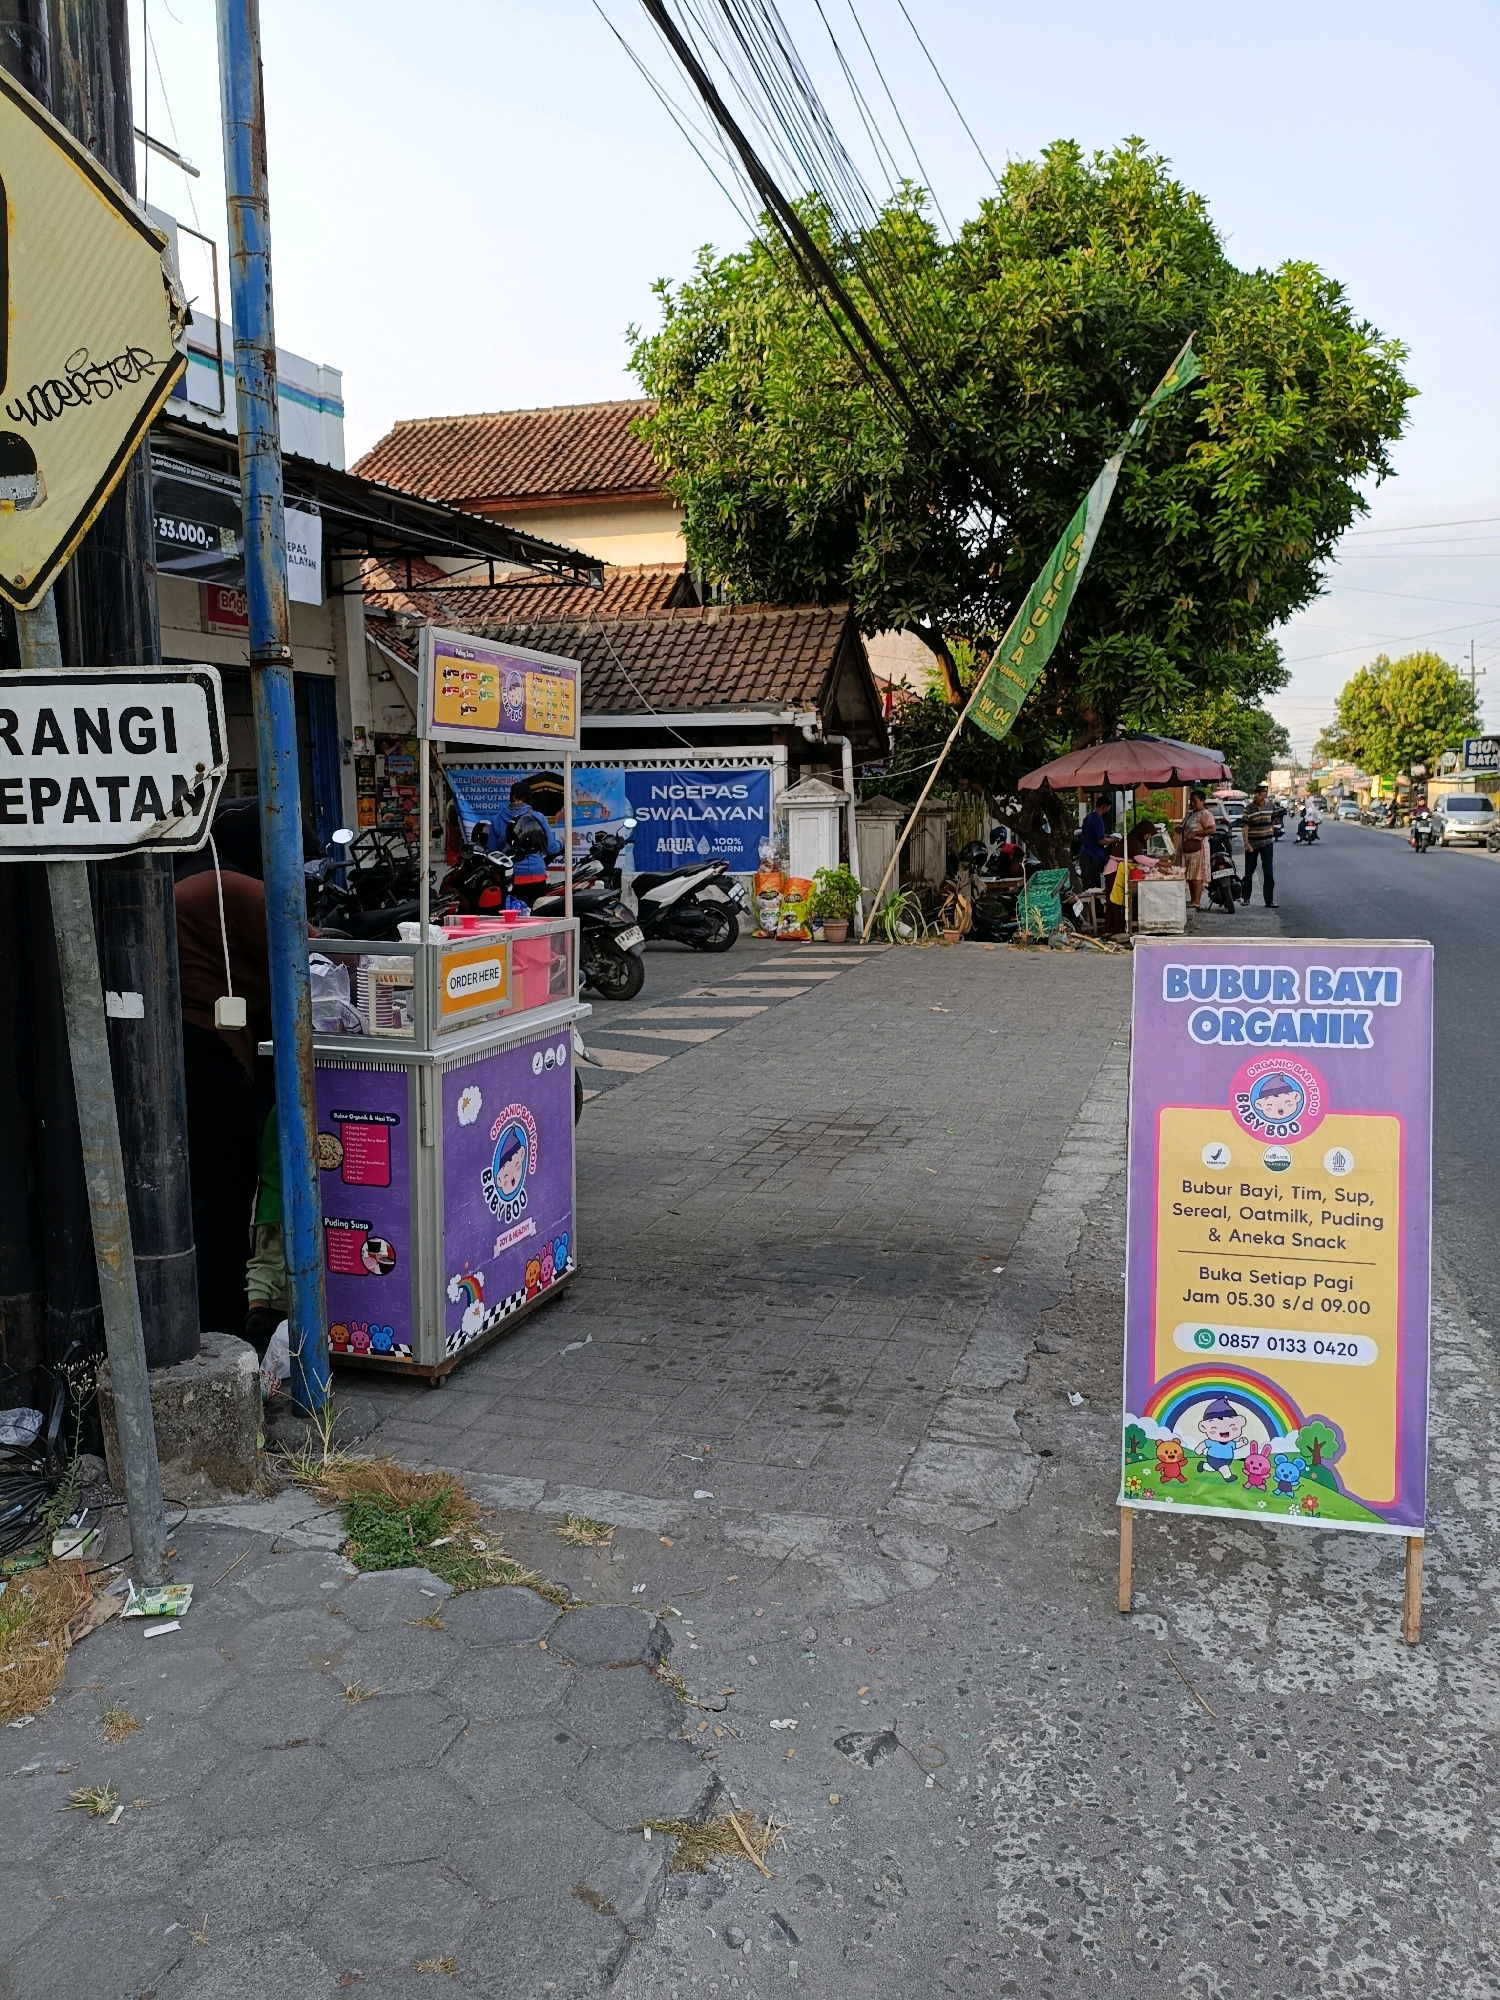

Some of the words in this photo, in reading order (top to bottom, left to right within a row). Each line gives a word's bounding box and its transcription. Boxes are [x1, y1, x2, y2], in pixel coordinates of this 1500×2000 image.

[287, 541, 308, 556] EPAS
[0, 706, 178, 755] RANGI
[472, 775, 482, 784] Le
[483, 775, 518, 785] Minerale
[652, 784, 749, 800] NGEPAS
[0, 774, 206, 825] EPATAN
[470, 802, 500, 811] UMROH
[635, 806, 764, 822] SWALAYAN
[656, 837, 694, 854] AQUA
[714, 837, 742, 845] 100%
[450, 972, 478, 990] ORDER
[478, 966, 499, 982] HERE
[1165, 966, 1299, 1003] BUBUR
[1308, 968, 1400, 1005] BAYI
[1190, 1008, 1371, 1046] ORGANIK
[1247, 1058, 1293, 1077] ORGANIC
[1292, 1062, 1317, 1089] BABY
[1308, 1086, 1320, 1117] FOOD
[1235, 1092, 1266, 1132] BABY
[1266, 1120, 1300, 1138] BOO
[490, 1104, 522, 1140] ORGANIC
[520, 1106, 536, 1135] BABY
[529, 1134, 538, 1174] FOOD
[481, 1167, 505, 1222] BABY
[505, 1189, 528, 1223] BOO
[1182, 1180, 1232, 1196] Bubur
[1240, 1184, 1284, 1201] Bayi,
[1292, 1186, 1327, 1204] Tim,
[1334, 1188, 1375, 1206] Sup,
[324, 1218, 349, 1230] Puding
[351, 1220, 369, 1230] Susu
[1172, 1202, 1231, 1221] Sereal,
[1240, 1206, 1314, 1226] Oatmilk,
[1321, 1212, 1384, 1230] Puding
[499, 1234, 508, 1248] JOY
[512, 1222, 530, 1240] HEALTHY
[1208, 1228, 1222, 1243] &
[1228, 1231, 1285, 1247] Aneka
[1292, 1234, 1347, 1250] Snack
[1199, 1267, 1242, 1284] Buka
[1250, 1270, 1308, 1290] Setiap
[1314, 1274, 1354, 1293] Pagi
[1182, 1288, 1220, 1304] Jam
[1227, 1292, 1276, 1308] 05.30
[1282, 1295, 1314, 1312] s/d
[1321, 1297, 1371, 1315] 09.00
[1218, 1332, 1260, 1350] 0857
[1267, 1336, 1307, 1354] 0133
[1314, 1340, 1358, 1357] 0420
